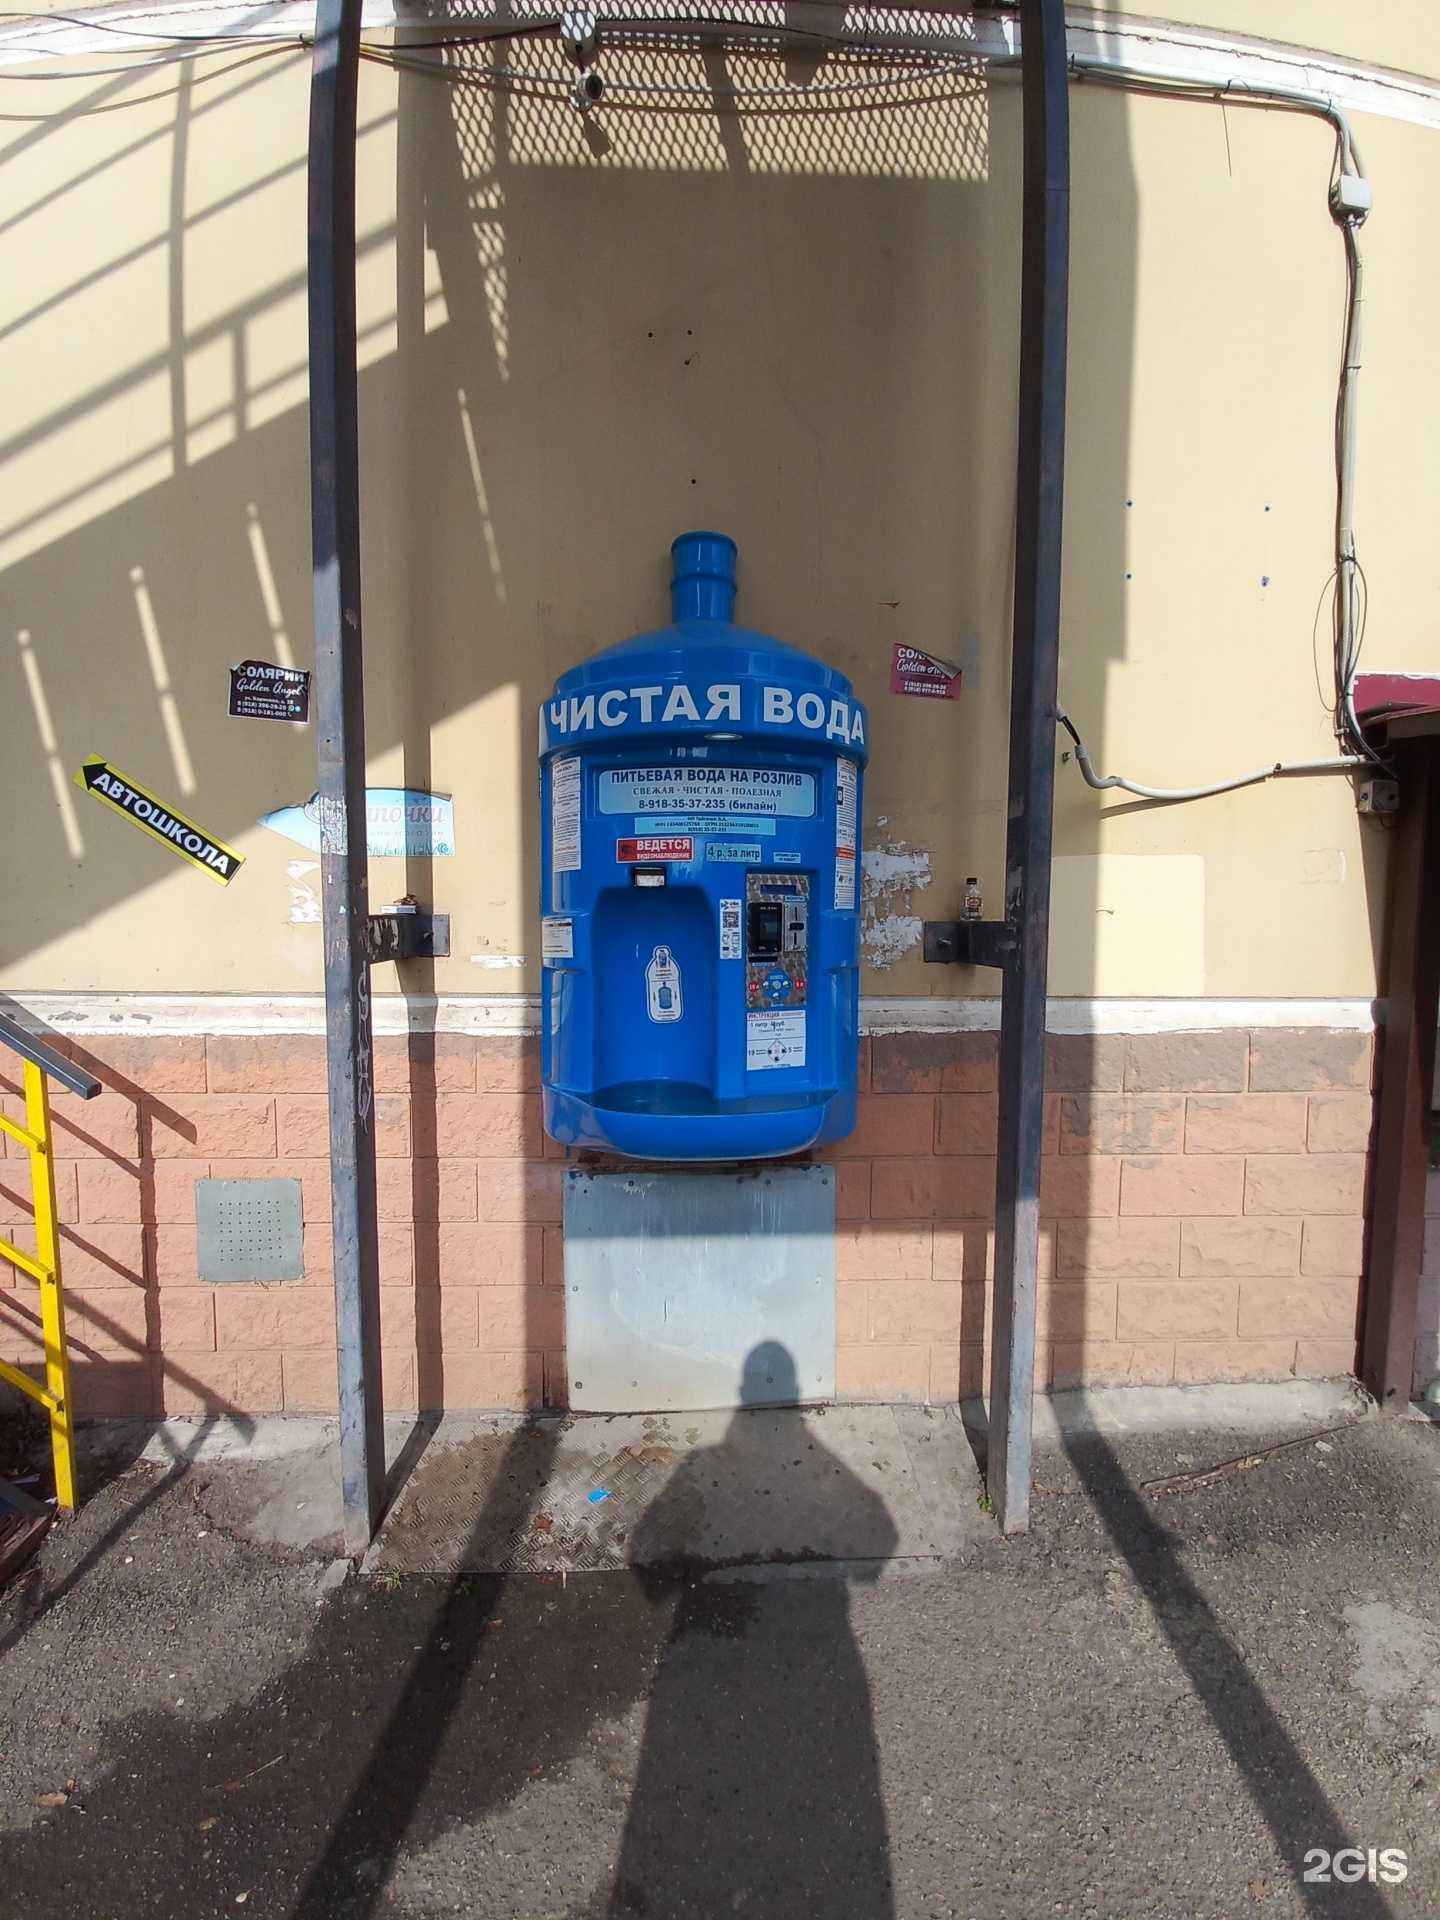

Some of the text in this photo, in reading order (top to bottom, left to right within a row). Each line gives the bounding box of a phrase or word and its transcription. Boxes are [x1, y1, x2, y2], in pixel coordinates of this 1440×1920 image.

[897, 659, 927, 673] Golden
[237, 678, 306, 698] Golden Angel
[550, 684, 865, 745] ЧИСТАЯ ВОДА
[611, 769, 803, 787] ПИТЬЕВАЯ ВОДА НА РОЗЛИВ
[633, 785, 782, 797] СВЕЖАЯ ЧИСТАЯ ПОЛЕЗНАЯ
[638, 799, 777, 813] 8-918-35-37-235 (билайн)
[92, 772, 230, 875] АВТОШКОЛА
[636, 839, 690, 852] ВЕДЕТСЯ
[708, 846, 760, 861] 4 р. за литр
